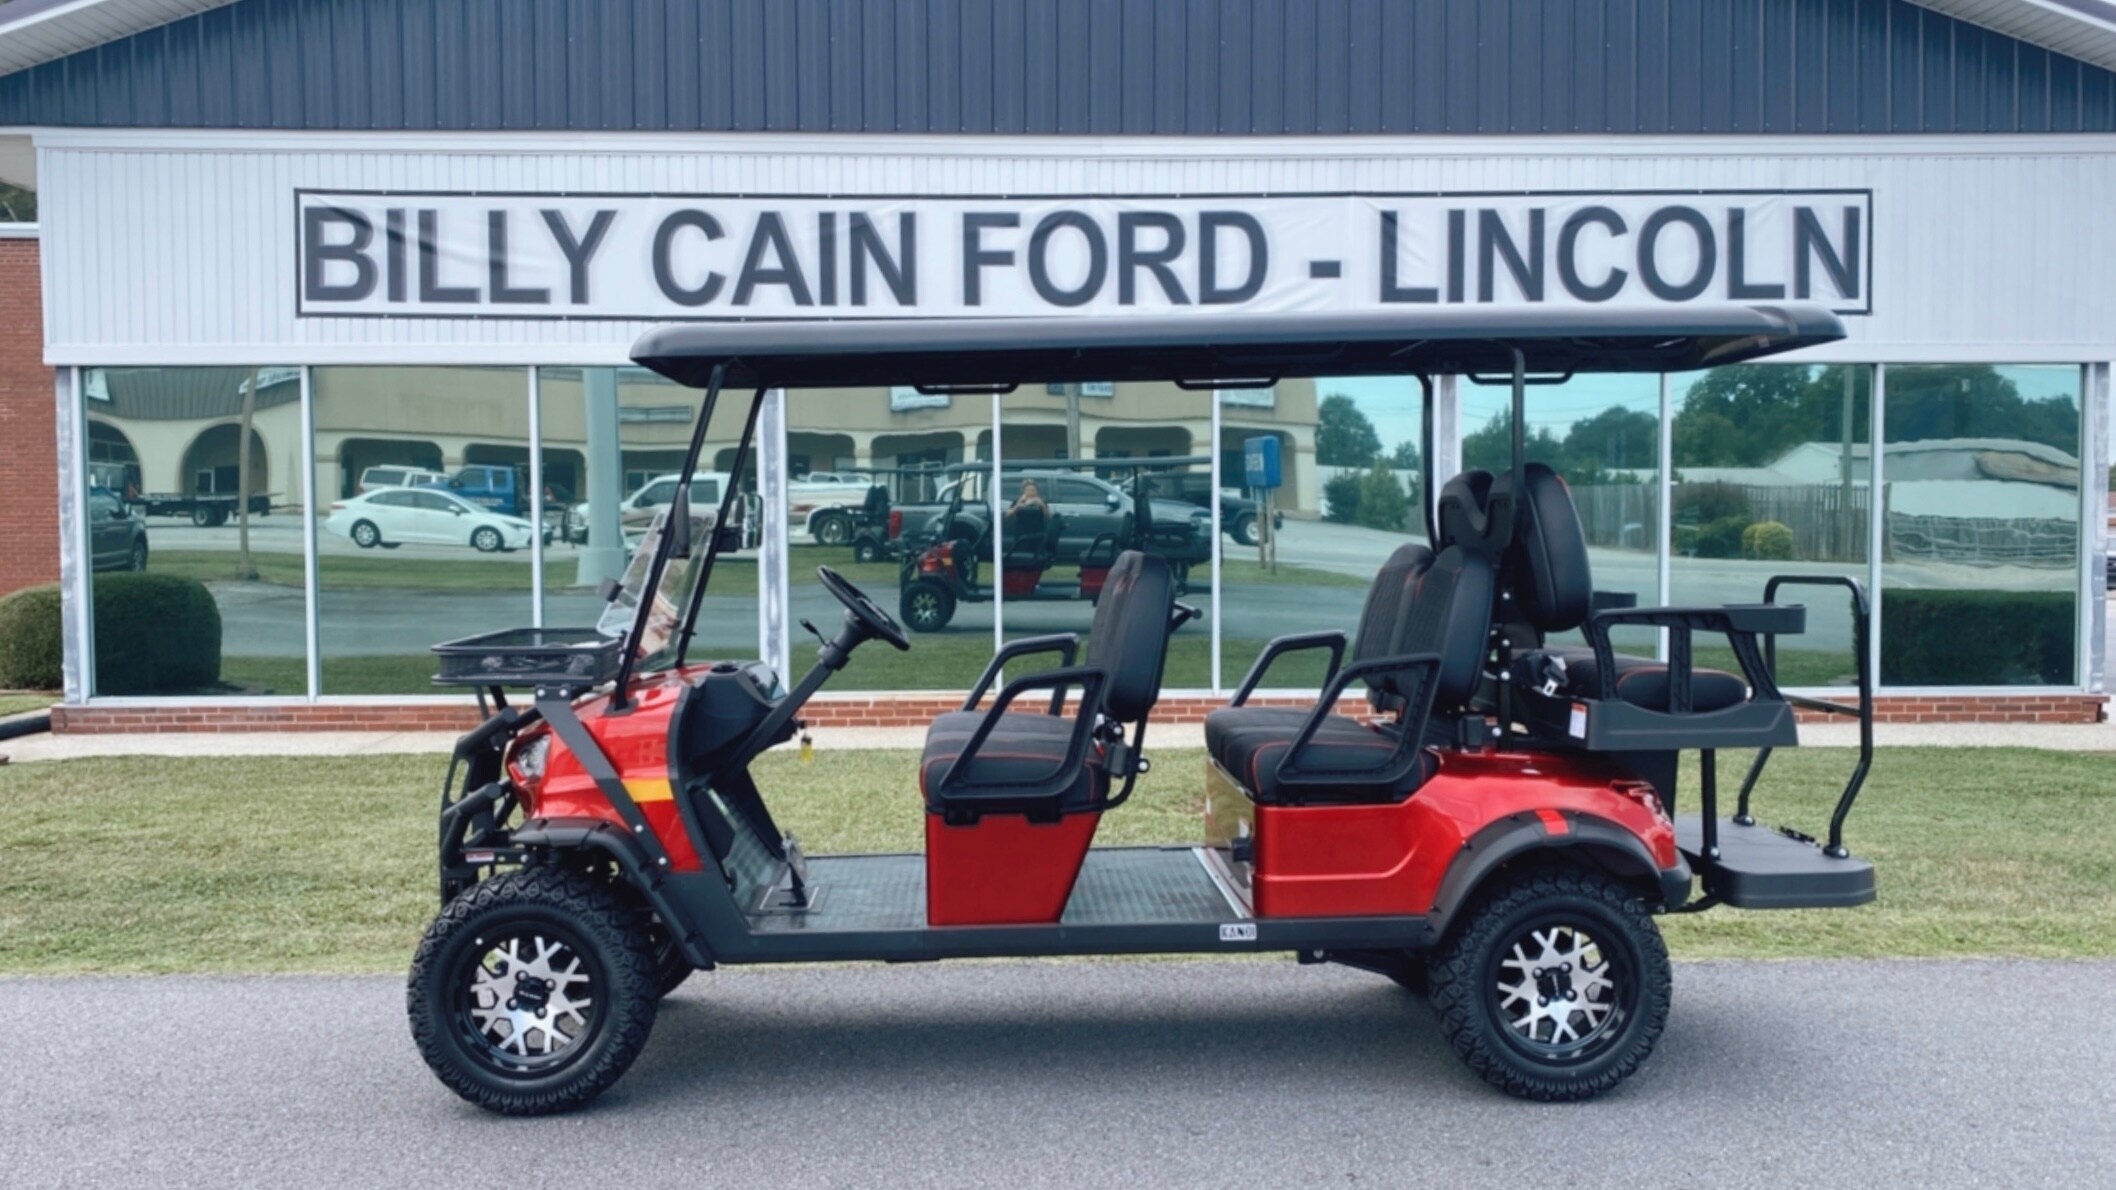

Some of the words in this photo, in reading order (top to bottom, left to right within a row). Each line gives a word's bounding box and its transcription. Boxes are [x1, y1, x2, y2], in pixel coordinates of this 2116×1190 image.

[302, 206, 618, 305] BILLY
[651, 208, 918, 308] CAIN
[962, 209, 1270, 308] FORD
[1309, 260, 1342, 279] -
[1379, 204, 1861, 304] LINCOLN
